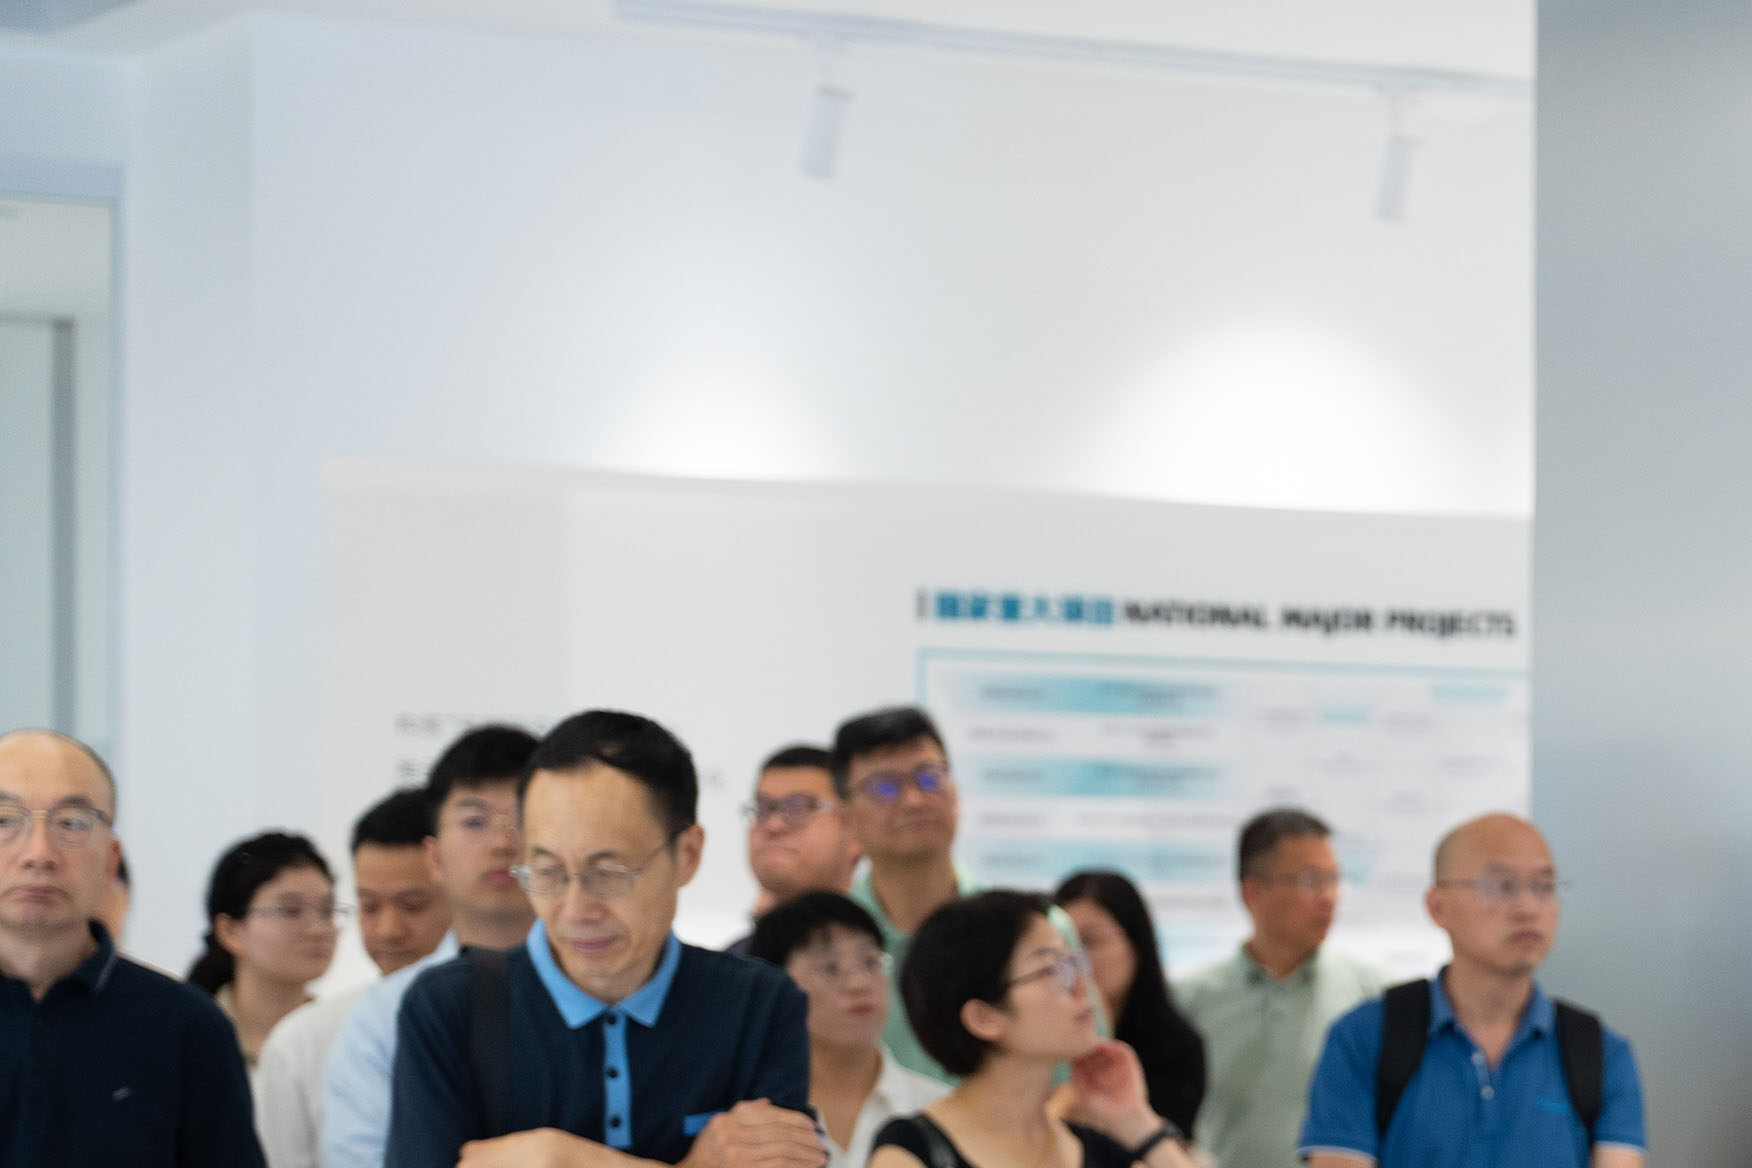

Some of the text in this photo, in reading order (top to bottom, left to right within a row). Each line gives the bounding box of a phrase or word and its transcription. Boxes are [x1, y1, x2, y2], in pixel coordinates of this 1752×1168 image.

[1122, 602, 1516, 639] NATIONAL MAJOR PROJECTS
